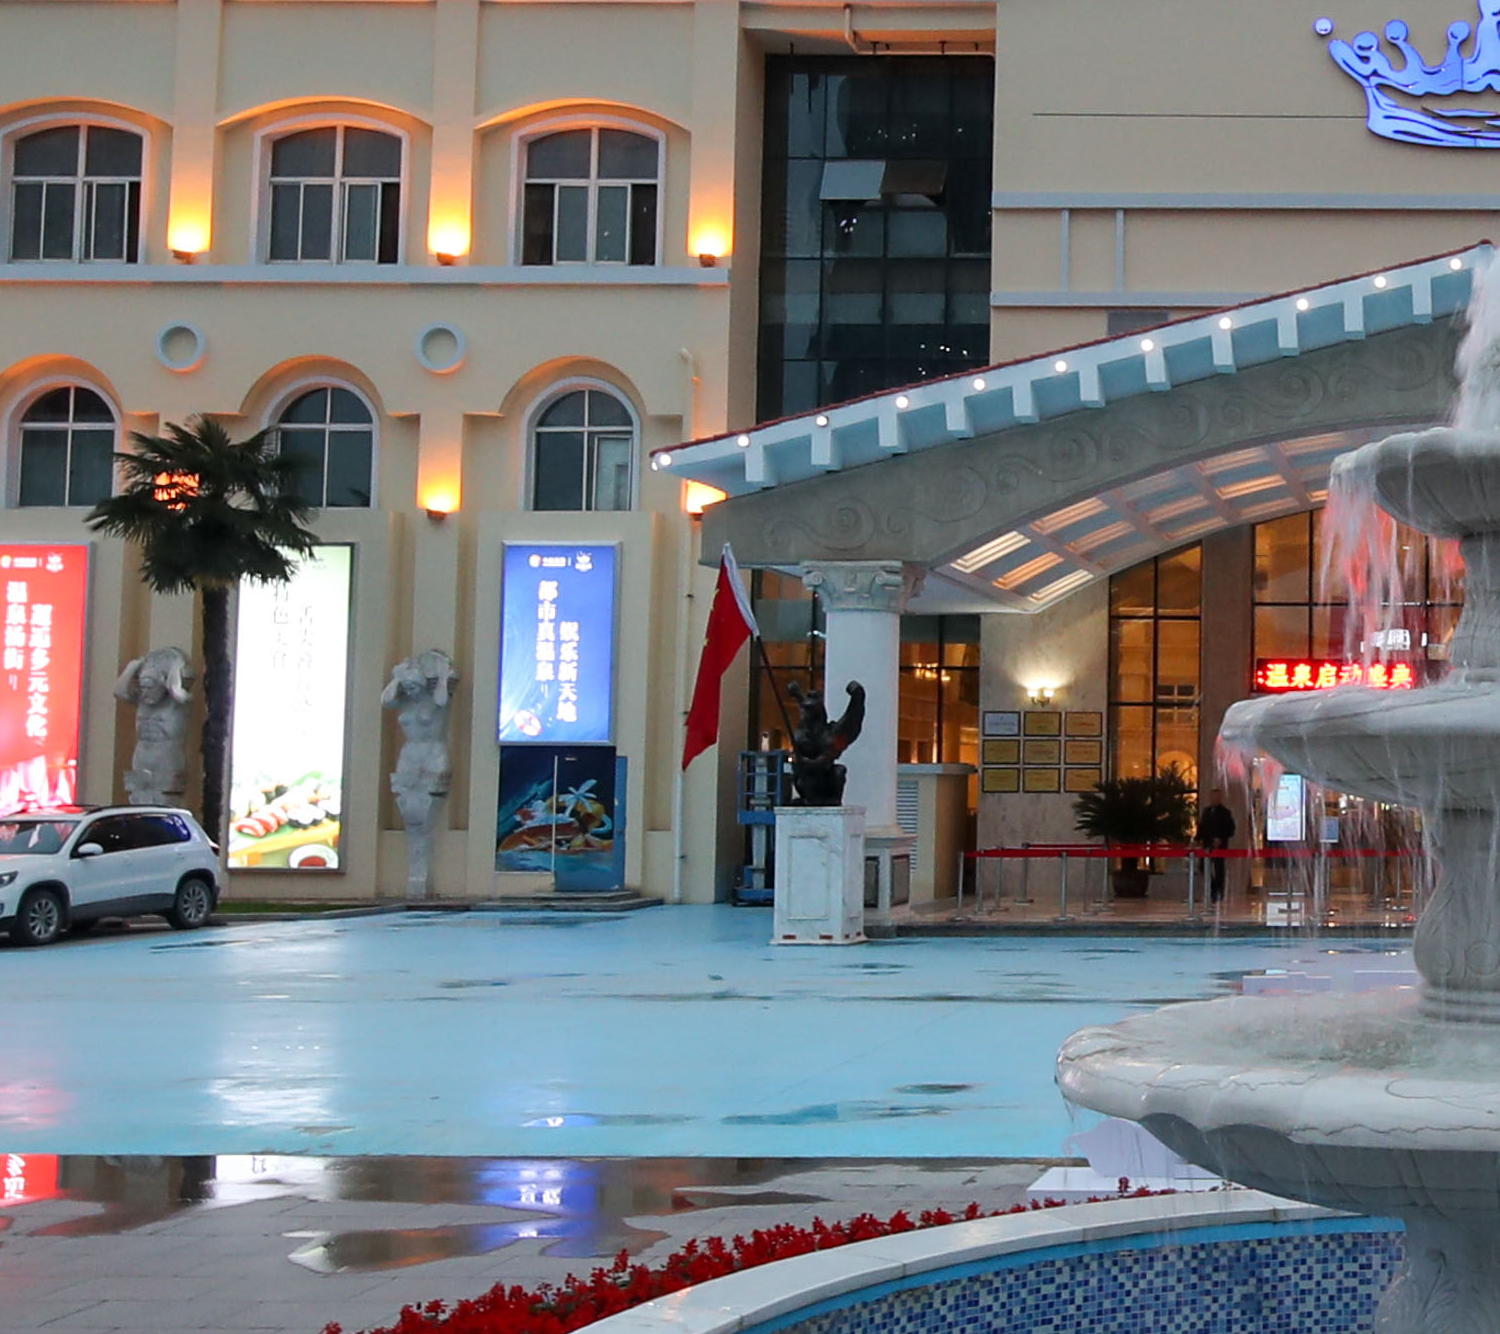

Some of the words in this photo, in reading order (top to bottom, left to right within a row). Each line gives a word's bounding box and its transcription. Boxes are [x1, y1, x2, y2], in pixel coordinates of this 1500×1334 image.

[1257, 662, 1413, 688] 温泉启动盛典
